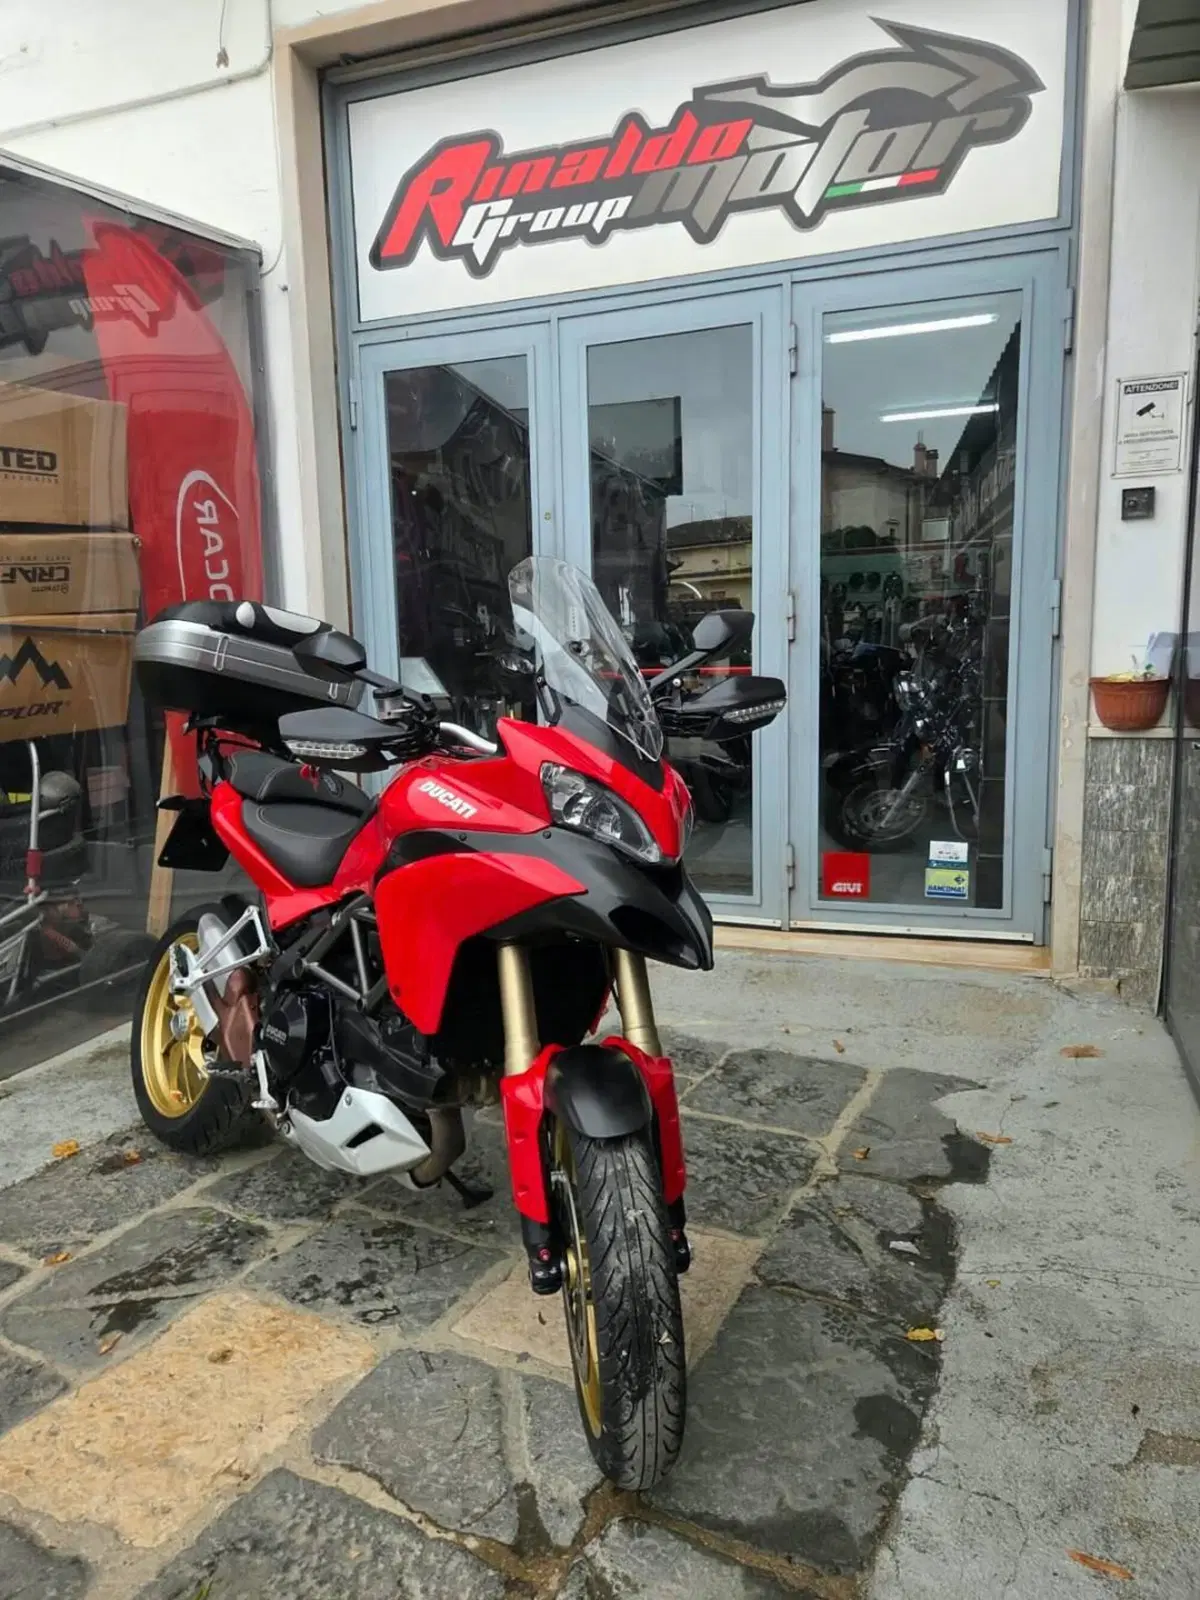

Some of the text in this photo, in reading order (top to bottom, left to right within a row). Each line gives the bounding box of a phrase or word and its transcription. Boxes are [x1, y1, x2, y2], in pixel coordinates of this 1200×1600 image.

[378, 107, 753, 258] Rinaldo
[453, 106, 1014, 267] Group motor
[418, 780, 478, 819] DUCATI
[832, 882, 863, 893] GIVI
